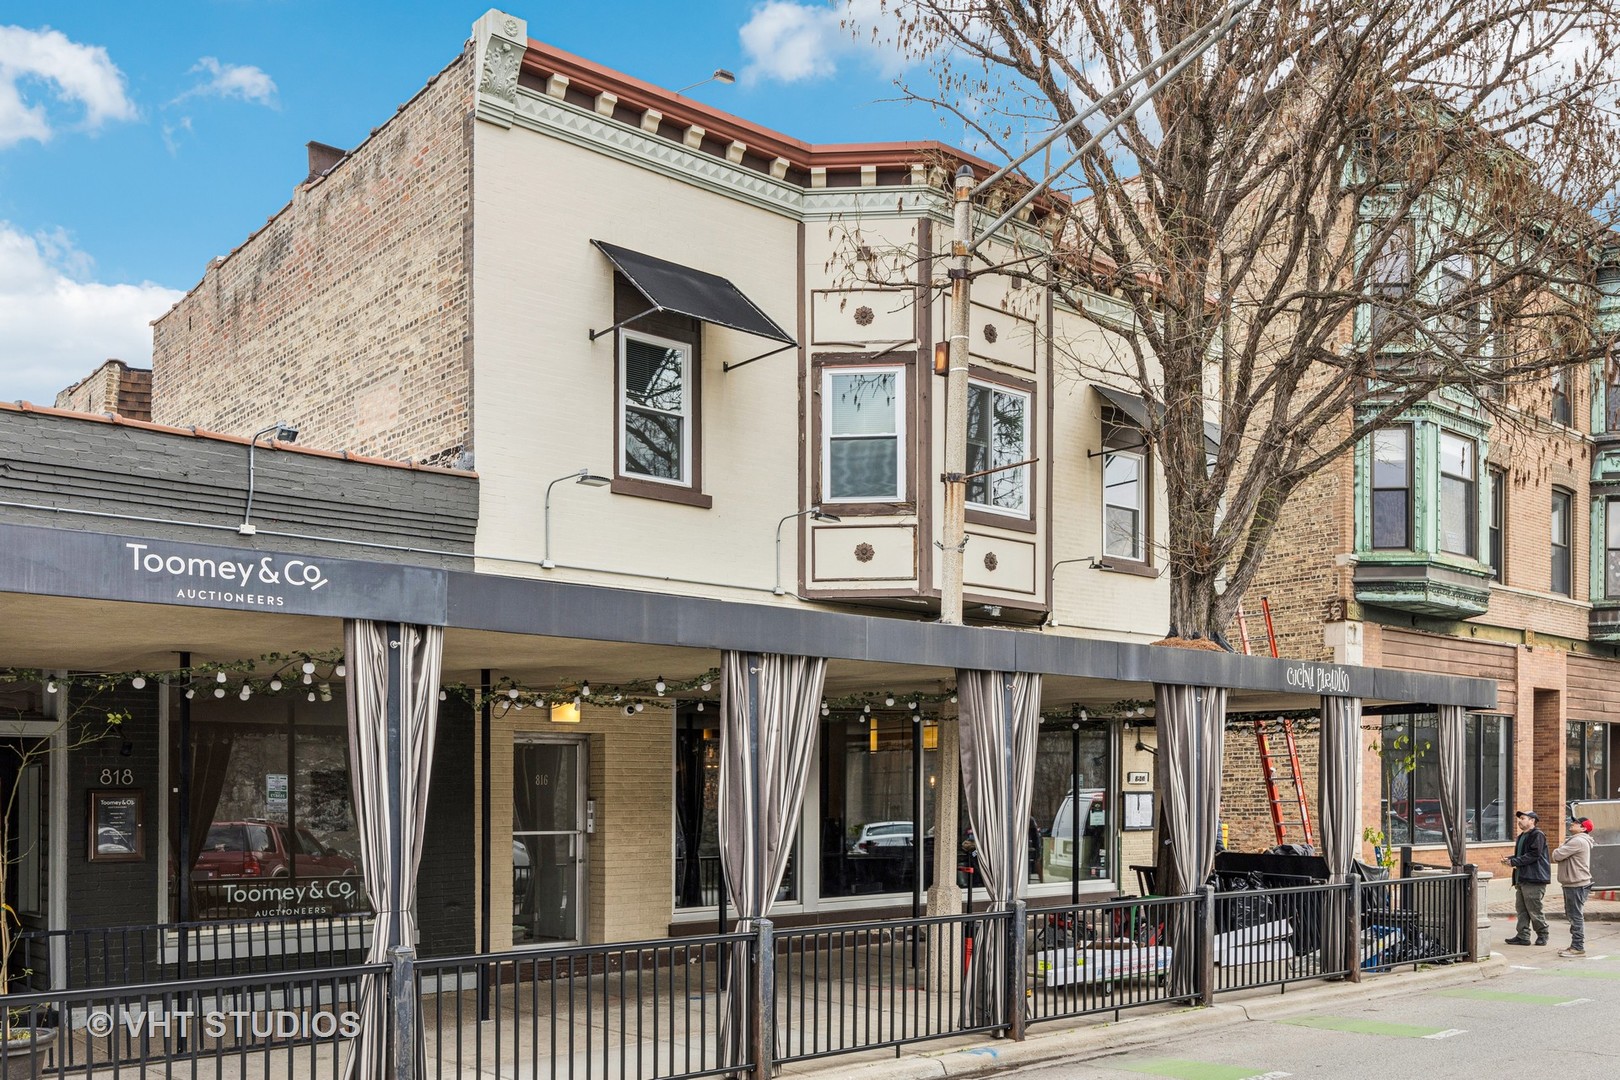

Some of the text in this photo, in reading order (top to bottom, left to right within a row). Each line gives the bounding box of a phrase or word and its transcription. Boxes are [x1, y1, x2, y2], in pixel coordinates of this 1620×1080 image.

[126, 543, 254, 587] Toomey
[258, 557, 281, 584] &
[176, 588, 285, 606] AUCTIONEERS
[100, 768, 134, 785] 818
[535, 774, 549, 786] 816
[222, 884, 306, 904] Toomey
[309, 880, 324, 899] &
[255, 906, 327, 918] AUCTIONEERS
